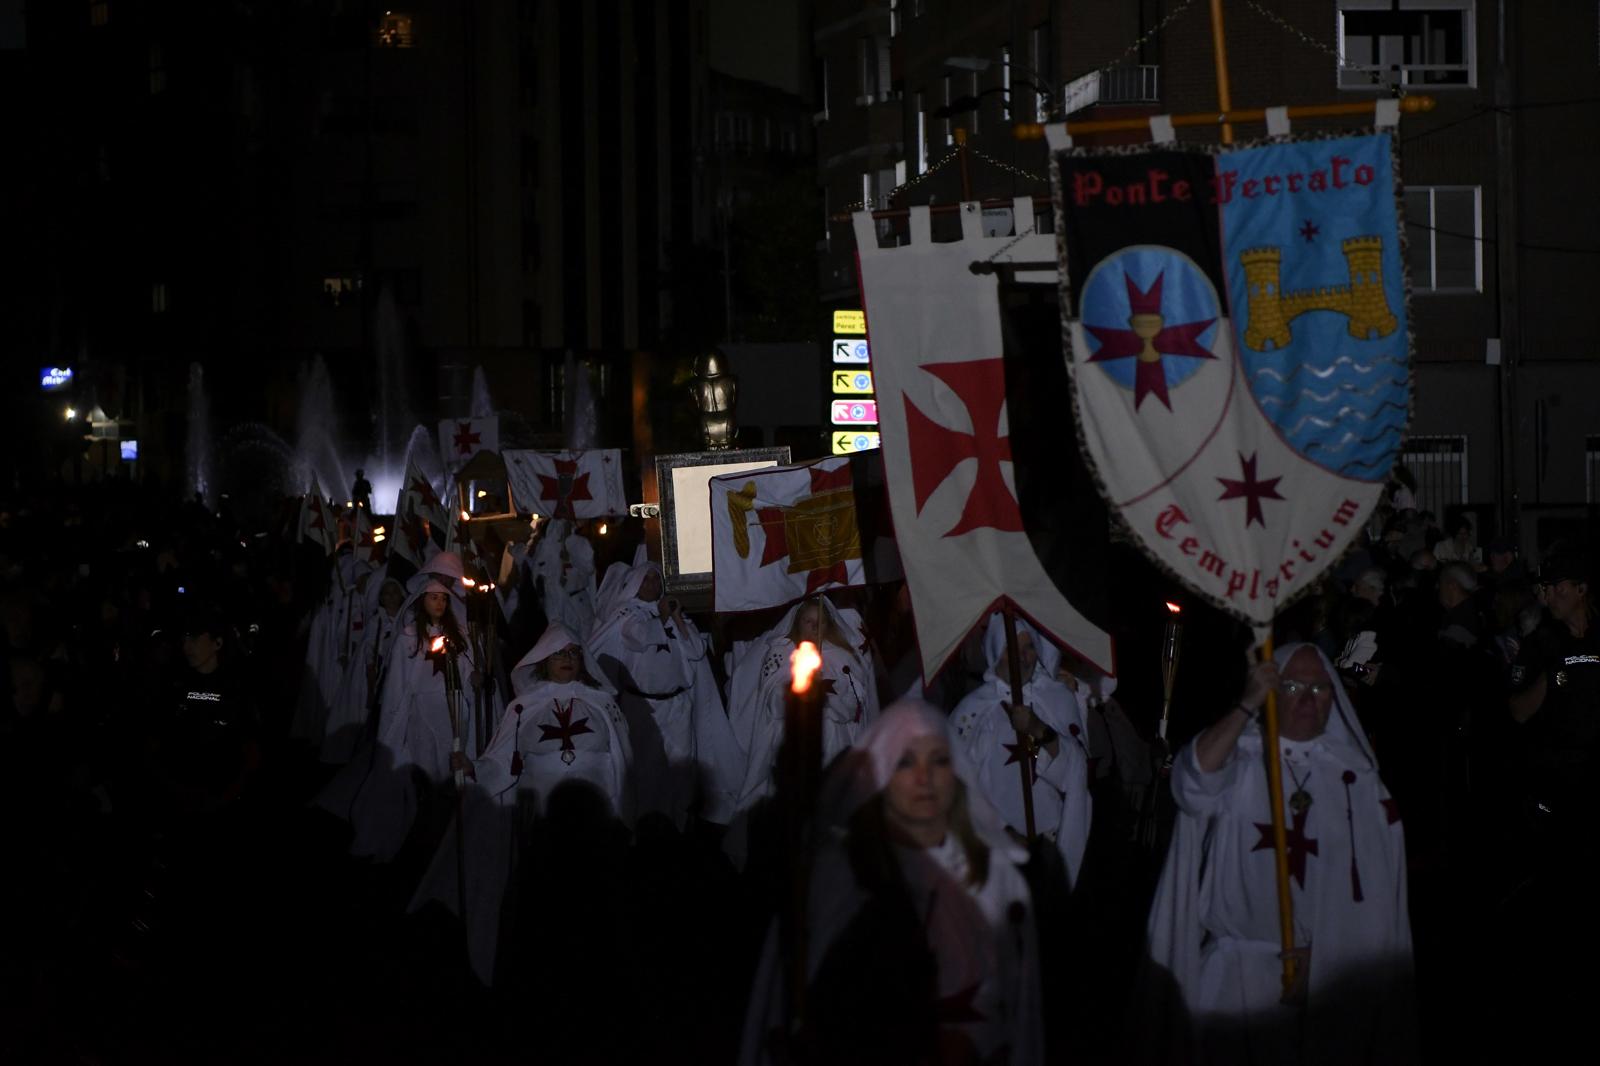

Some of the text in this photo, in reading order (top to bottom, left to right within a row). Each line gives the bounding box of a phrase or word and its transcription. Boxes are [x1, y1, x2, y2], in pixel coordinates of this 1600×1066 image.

[1072, 154, 1375, 208] Ponte Ferrato
[1154, 499, 1360, 601] Templarium
